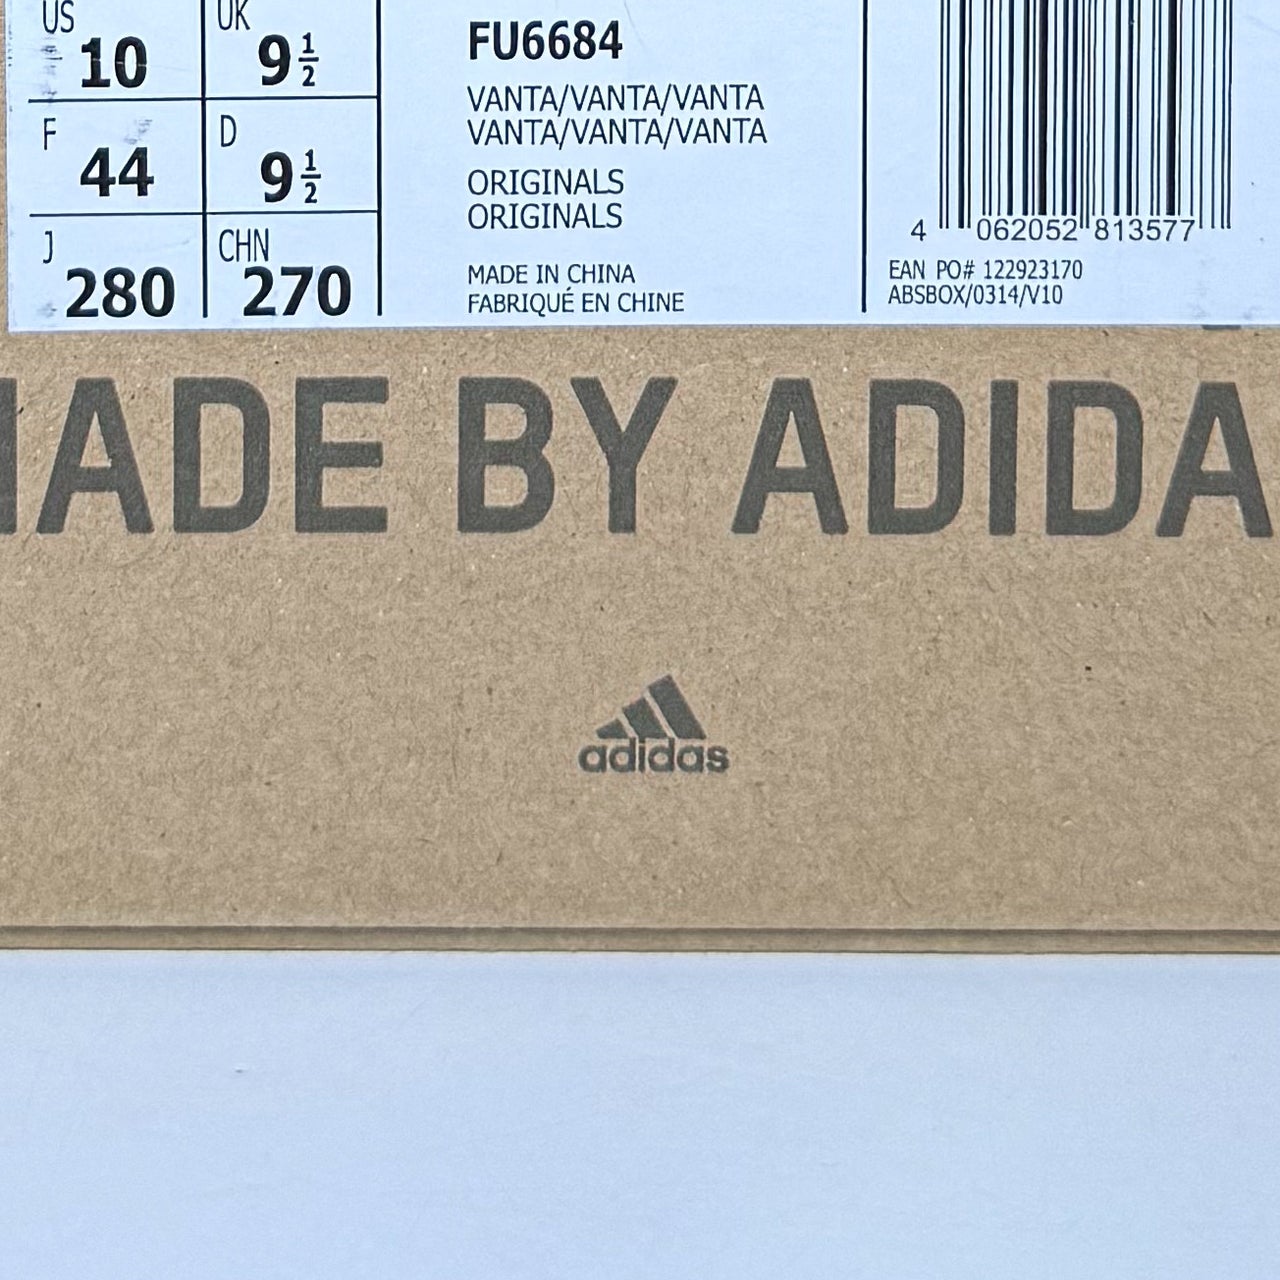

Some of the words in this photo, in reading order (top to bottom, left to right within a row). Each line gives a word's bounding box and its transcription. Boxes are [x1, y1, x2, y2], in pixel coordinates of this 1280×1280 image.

[42, 0, 75, 35] US
[469, 19, 623, 61] FU6684
[81, 35, 148, 89] 10
[466, 83, 765, 118] VANTA/VANTA/VANTA
[43, 117, 57, 151] F
[220, 114, 237, 148] D
[466, 116, 768, 151] VANTA/VANTA/VANTA
[79, 146, 155, 198] 44
[467, 168, 624, 196] ORIGINALS
[467, 202, 623, 230] ORIGINALS
[42, 230, 53, 265] J
[218, 227, 269, 263] CHN
[468, 264, 528, 285] MADE
[536, 263, 559, 285] IN
[567, 263, 636, 284] CHINA
[889, 259, 926, 280] EAN
[936, 259, 976, 281] PO#
[983, 259, 1083, 280] 122923170
[66, 266, 175, 318] 280
[243, 265, 352, 317] 270
[468, 286, 575, 318] FABRIQUÉ
[581, 292, 610, 313] EN
[617, 292, 685, 313] CHINE
[887, 283, 1063, 309] ABSBOX/0314/V10
[457, 376, 678, 535] BY
[578, 736, 730, 774] adidas
